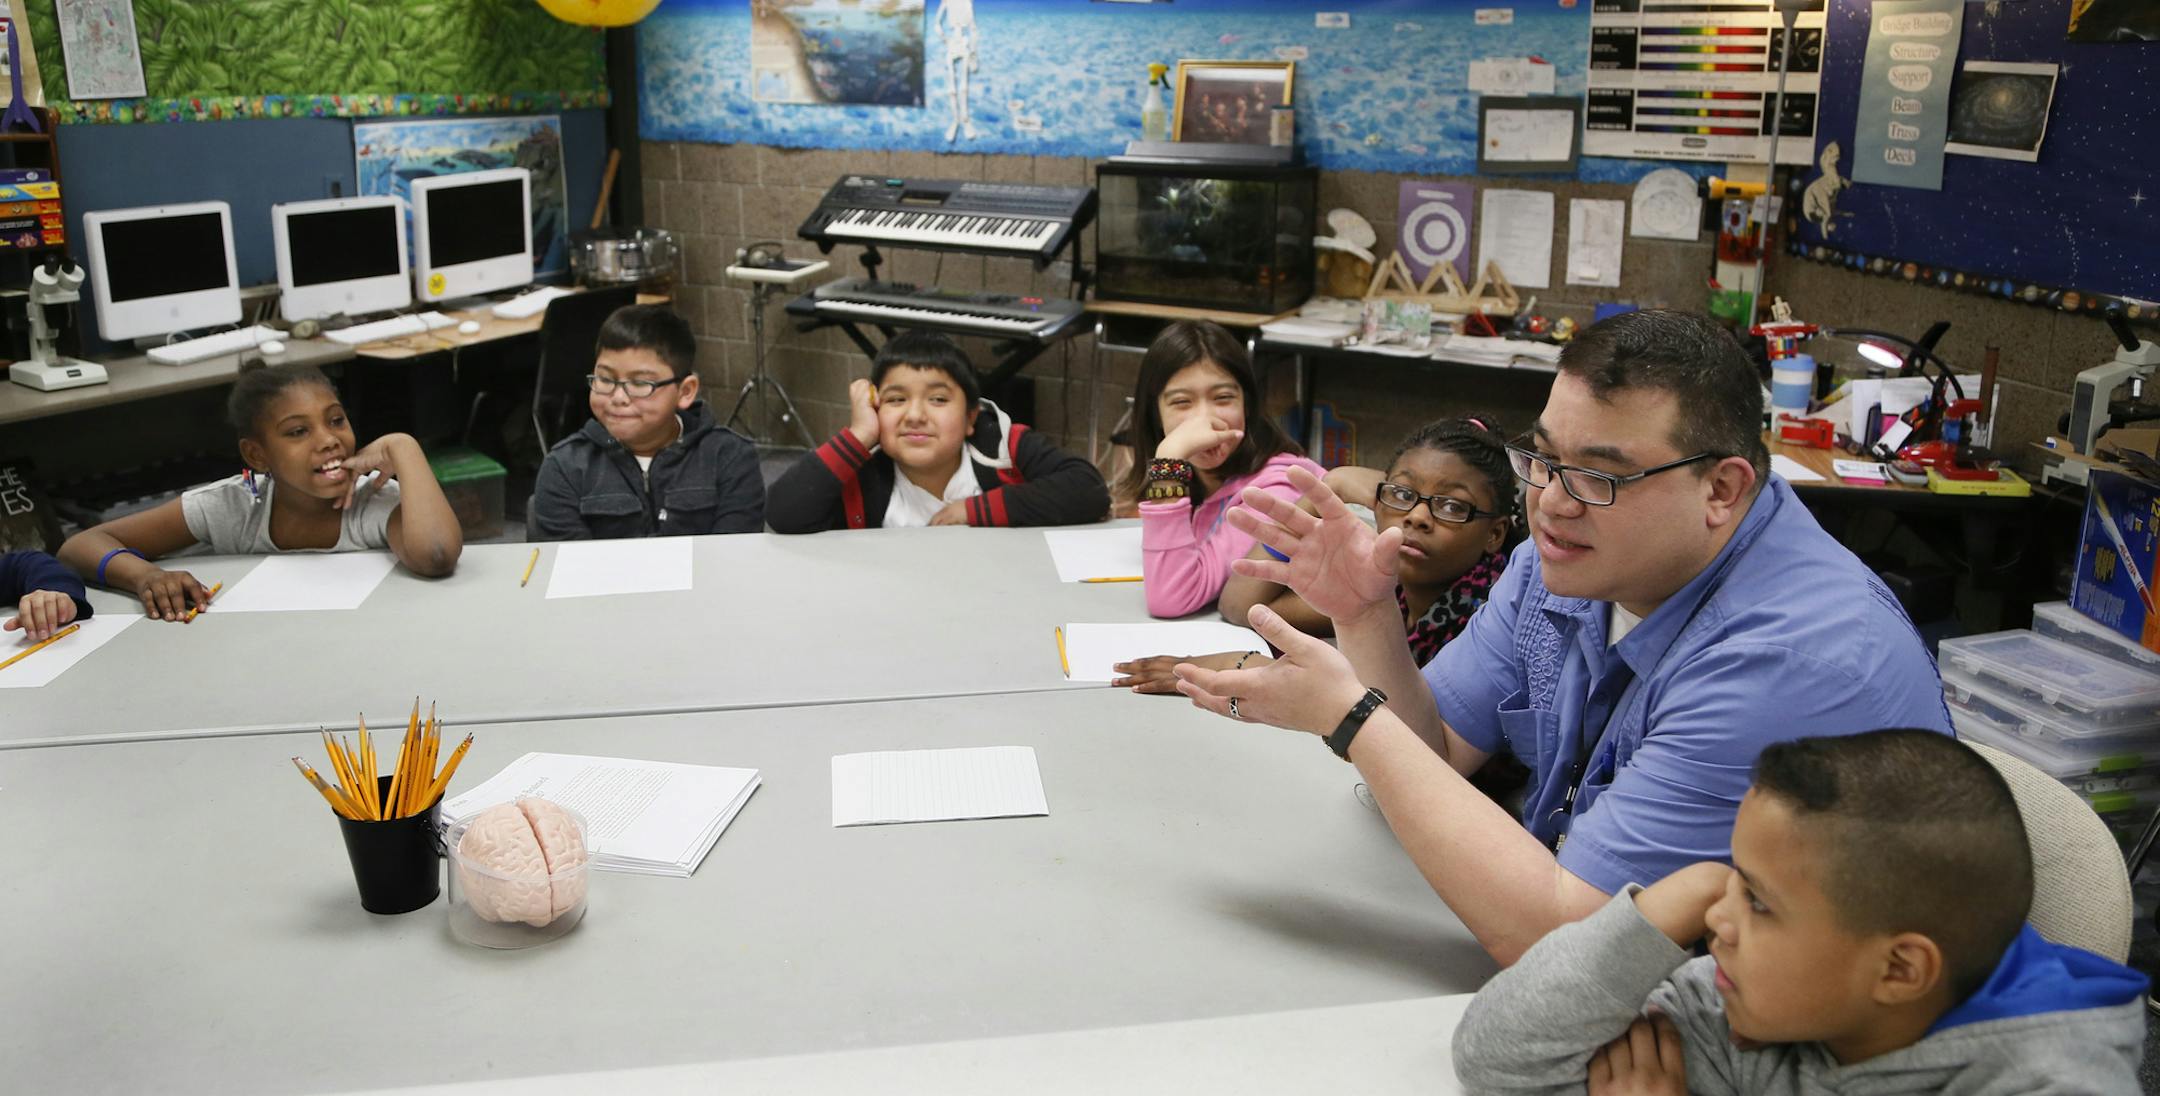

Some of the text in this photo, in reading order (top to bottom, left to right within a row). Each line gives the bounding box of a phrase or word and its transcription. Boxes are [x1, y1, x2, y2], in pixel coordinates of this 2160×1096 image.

[1882, 17, 1950, 32] Bridge Building
[1892, 44, 1939, 58] Structure
[1891, 69, 1930, 87] Support
[1893, 99, 1921, 112] Beam
[1890, 124, 1918, 138] Truss
[1887, 149, 1914, 163] Deck
[0, 466, 22, 486] HE
[0, 486, 34, 516] ES
